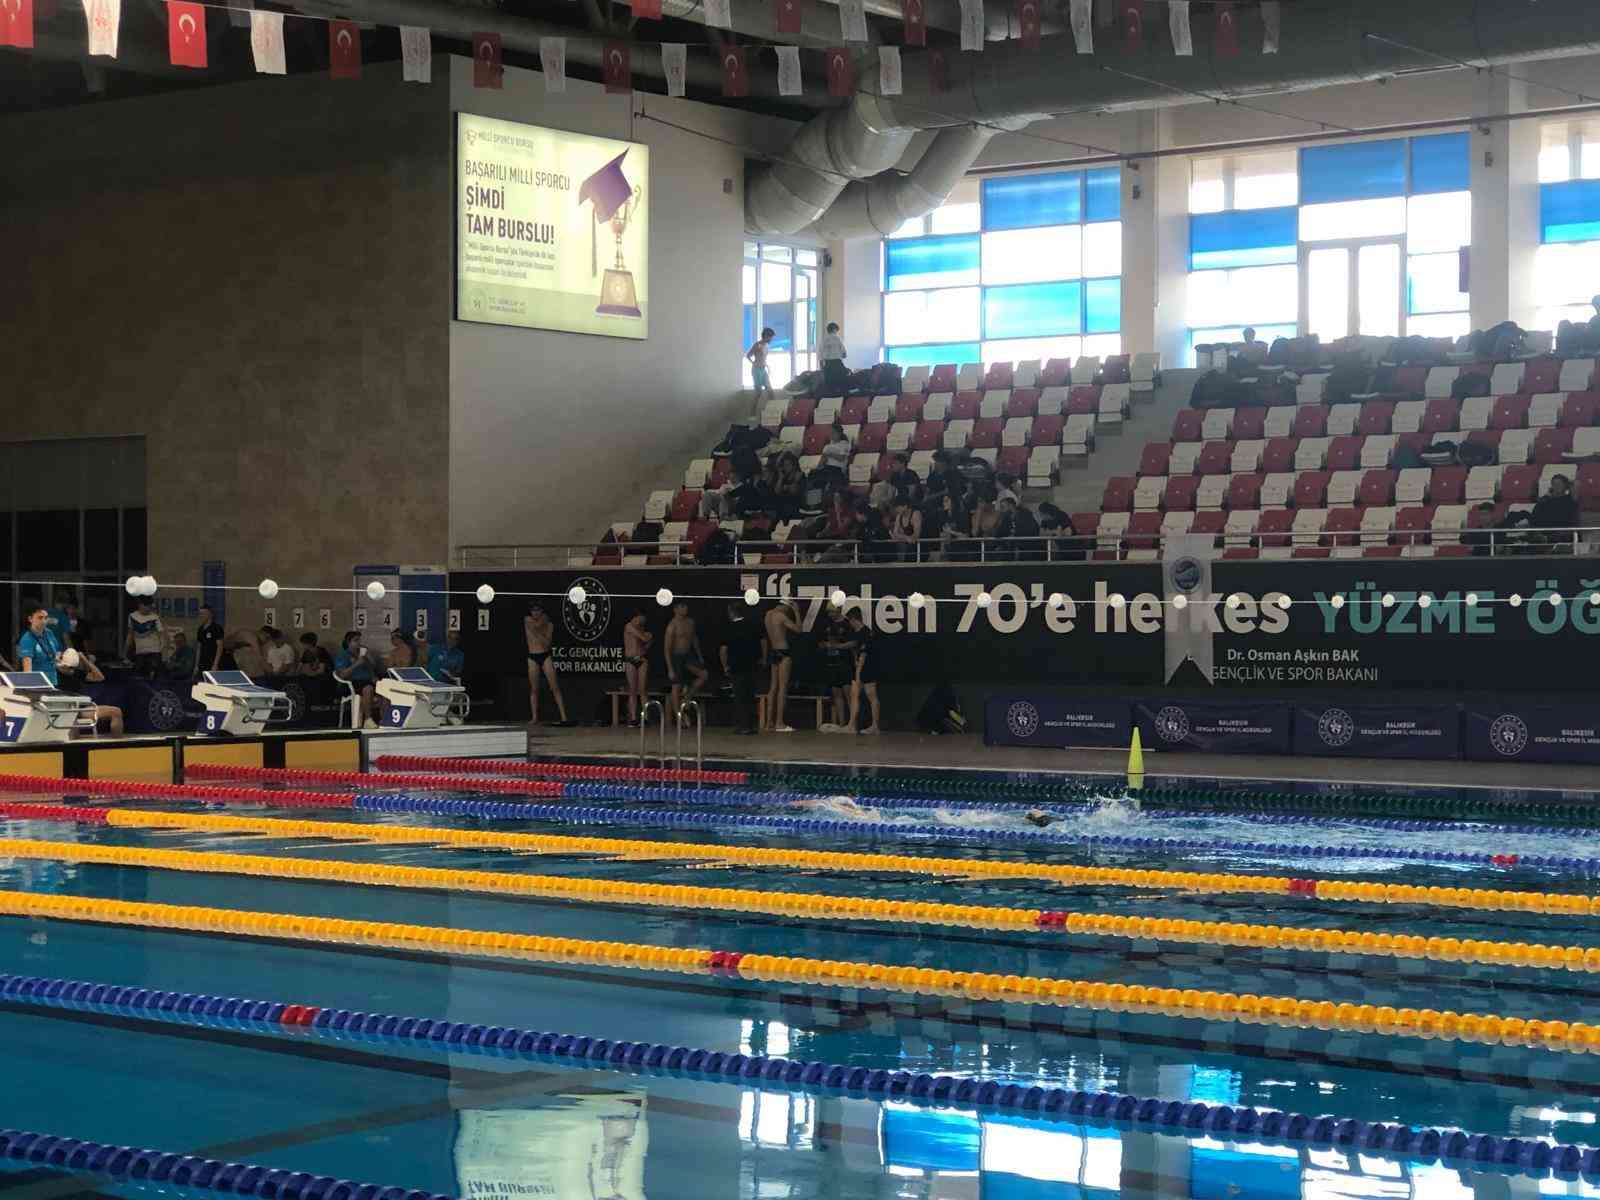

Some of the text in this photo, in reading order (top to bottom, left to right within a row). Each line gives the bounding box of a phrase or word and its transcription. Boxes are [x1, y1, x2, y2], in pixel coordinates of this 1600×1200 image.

[465, 159, 570, 191] BAŞARILI MİLLİ SPORCU
[466, 183, 505, 211] ŞİMDİ
[466, 213, 555, 245] TAM BURSLU!
[1313, 580, 1496, 634] YÜZME
[568, 645, 609, 660] GENÇLİK
[610, 647, 623, 658] VE
[1227, 649, 1360, 663] Dr. Osman Aşkın BAK
[552, 661, 573, 673] POR
[1212, 665, 1378, 683] GENÇLİK VE SPOR BAKANI
[206, 715, 215, 730] 8
[391, 709, 400, 724] 9
[5, 721, 15, 737] 7
